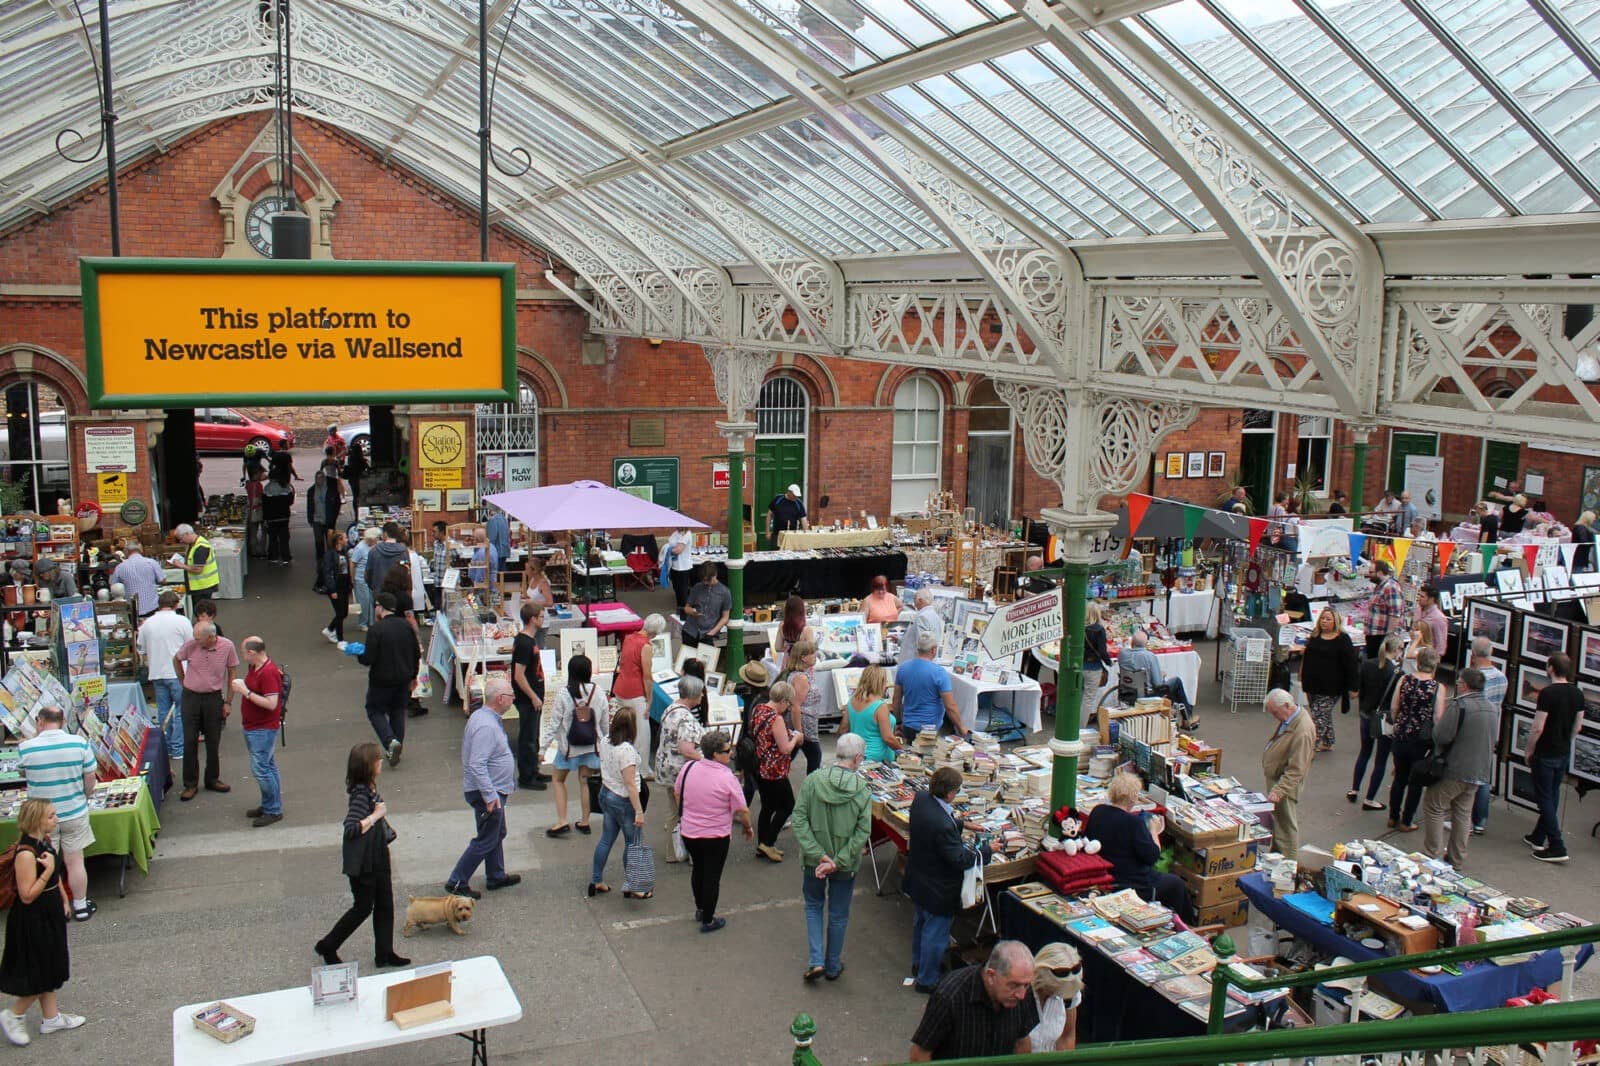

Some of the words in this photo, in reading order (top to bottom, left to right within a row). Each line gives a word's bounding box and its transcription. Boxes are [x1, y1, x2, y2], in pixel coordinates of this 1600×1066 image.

[200, 307, 259, 329] This
[268, 307, 376, 333] platform
[386, 308, 410, 329] to
[144, 338, 288, 361] Newcastle
[297, 338, 336, 360] via
[345, 337, 463, 359] Wallsend
[427, 434, 456, 452] Station
[1006, 602, 1037, 621] TYNEMOUTH
[1037, 597, 1058, 611] MARKETS
[1001, 621, 1030, 642] MORE
[1031, 612, 1062, 632] STALLS
[999, 641, 1020, 655] OVER
[1020, 636, 1035, 650] THE
[1035, 628, 1062, 643] BRIDGE
